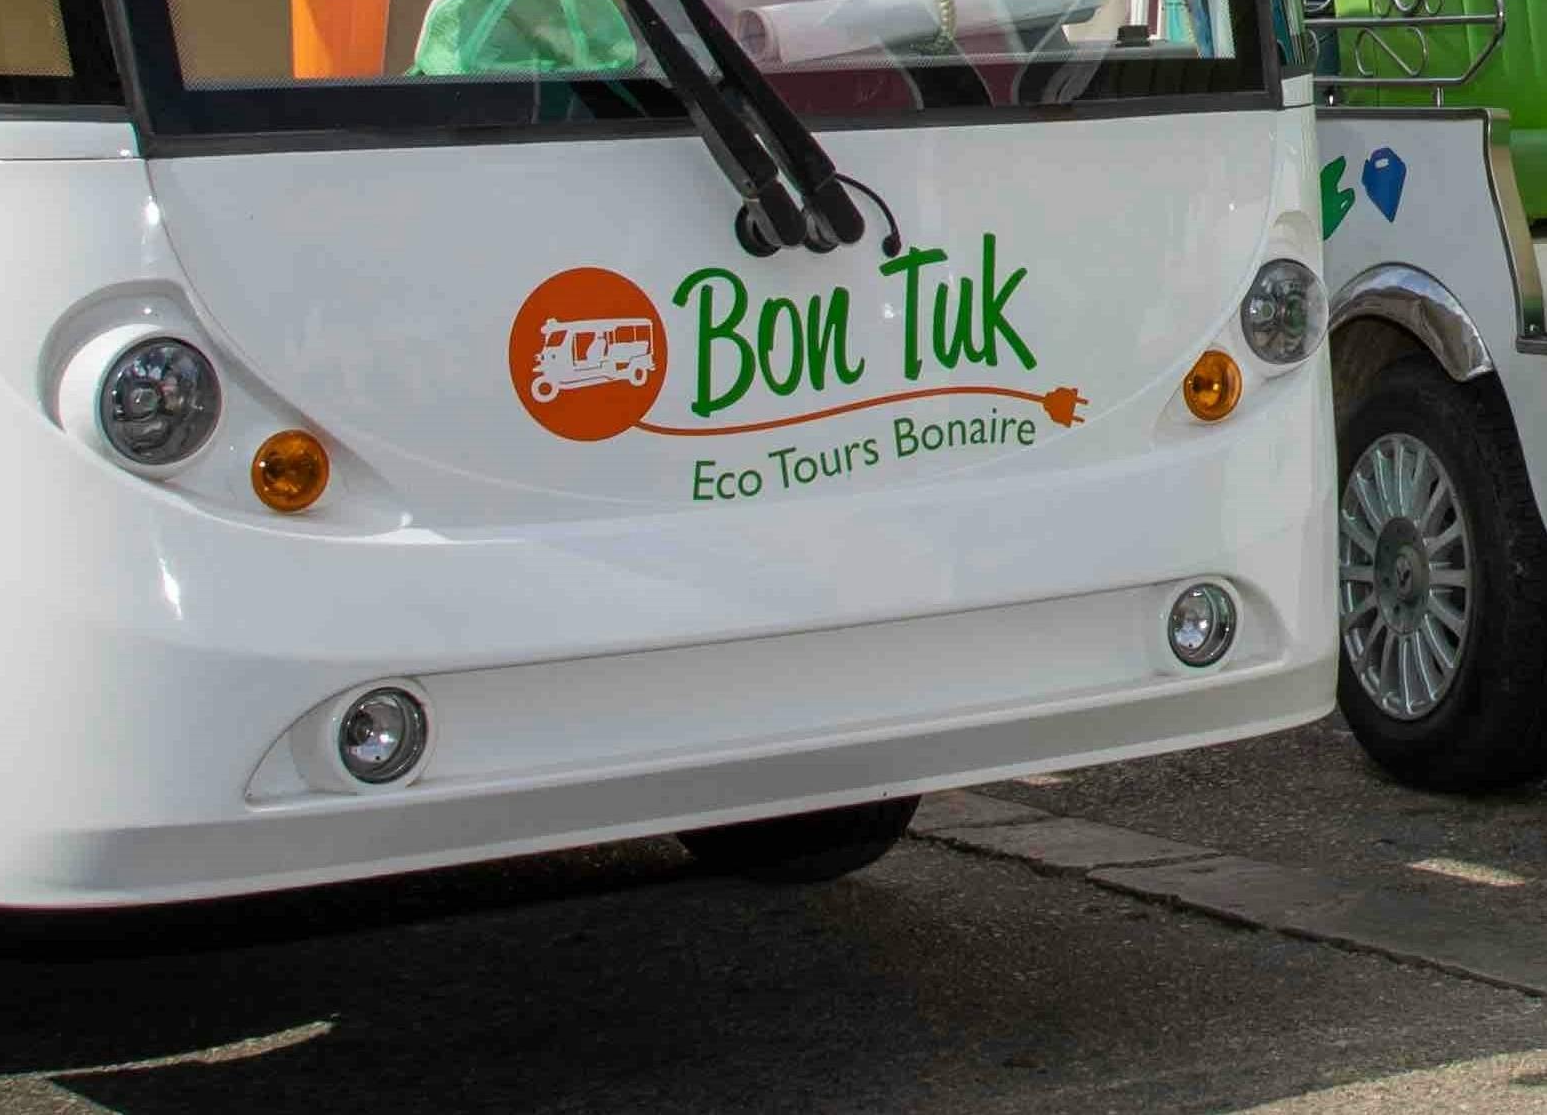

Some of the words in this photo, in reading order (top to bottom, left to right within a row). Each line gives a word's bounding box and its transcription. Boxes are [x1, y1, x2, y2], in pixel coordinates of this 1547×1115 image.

[672, 267, 865, 417] Bon
[879, 233, 1037, 380] Tuk
[692, 460, 763, 501] Eco
[768, 436, 880, 489] Tours
[894, 408, 1037, 458] Bonaire
